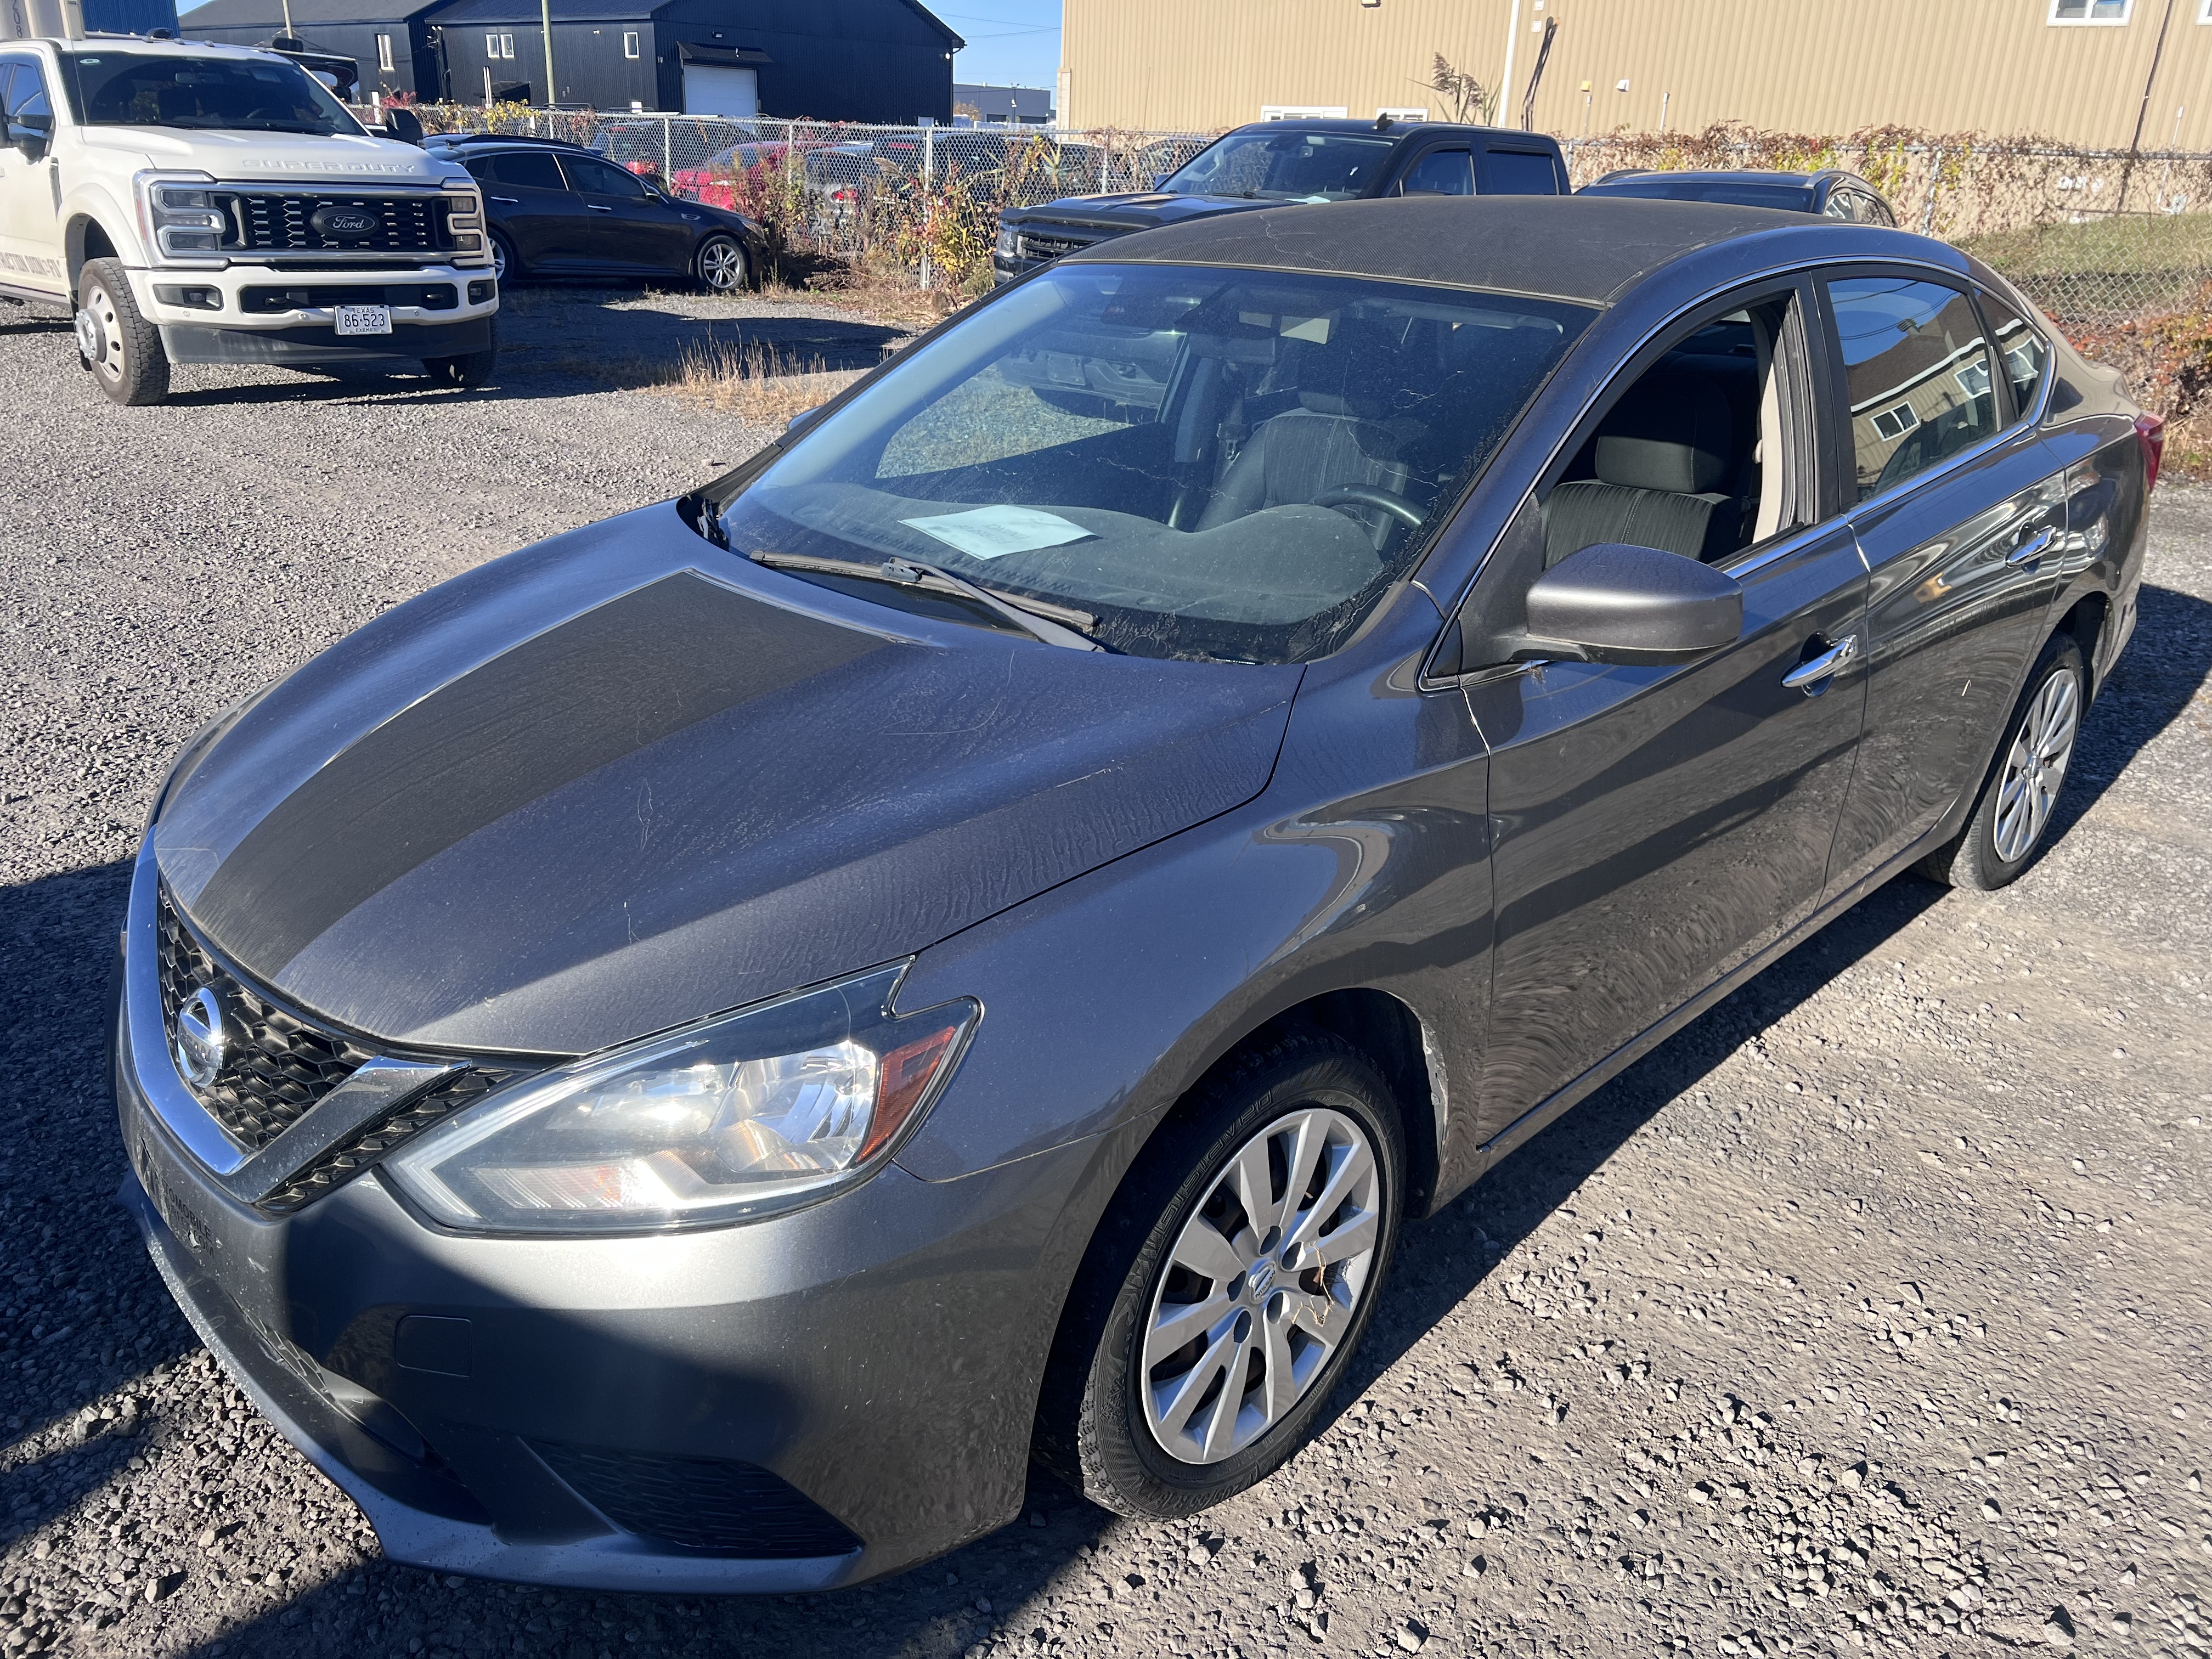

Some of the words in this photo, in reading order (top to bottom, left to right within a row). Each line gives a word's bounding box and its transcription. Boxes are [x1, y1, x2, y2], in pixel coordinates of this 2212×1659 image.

[242, 160, 344, 171] SUPER
[347, 162, 414, 173] DUTY
[332, 216, 364, 229] Ford
[1255, 1269, 1276, 1298] NISSAN
